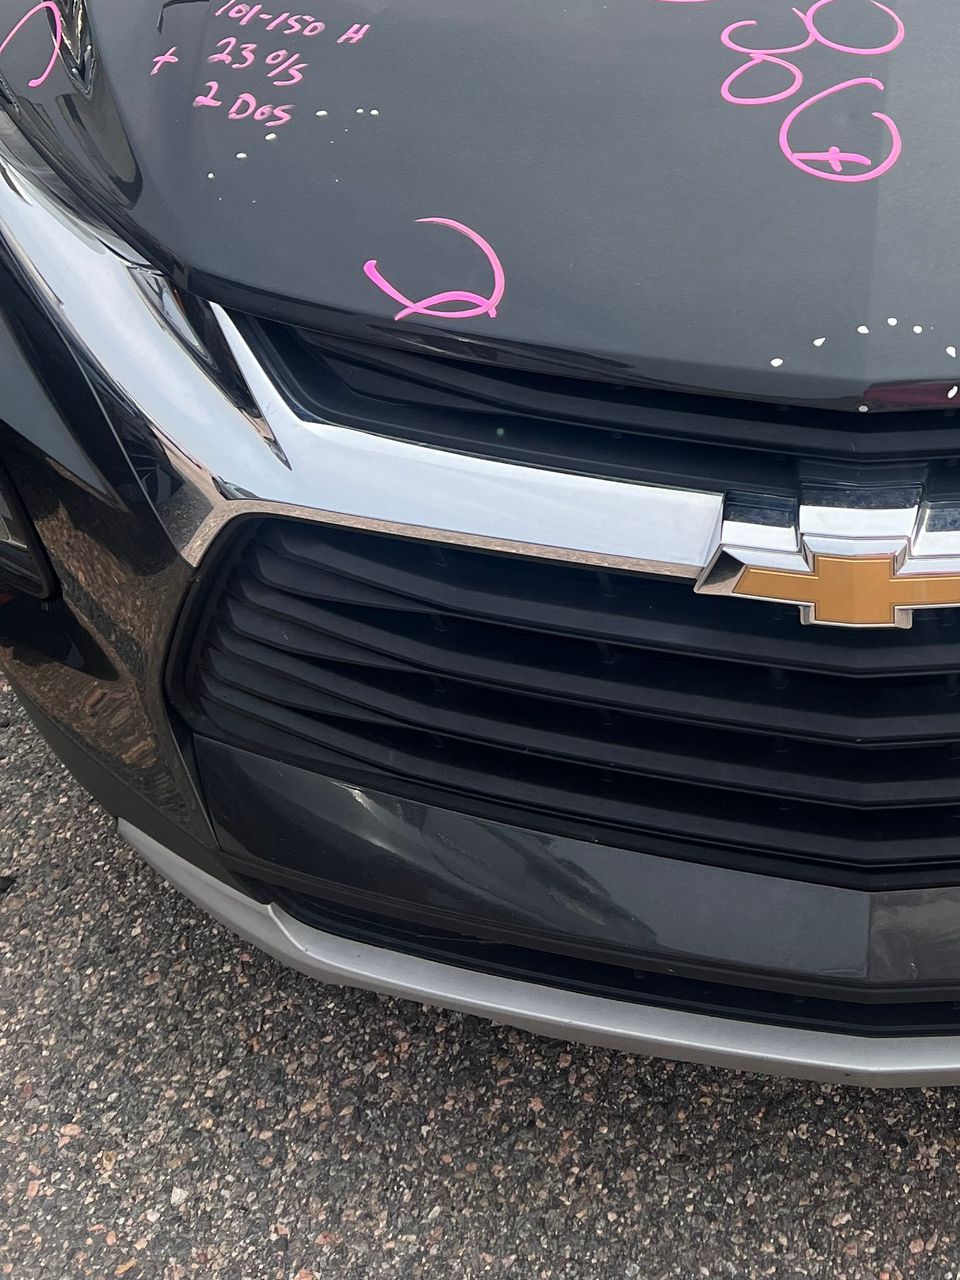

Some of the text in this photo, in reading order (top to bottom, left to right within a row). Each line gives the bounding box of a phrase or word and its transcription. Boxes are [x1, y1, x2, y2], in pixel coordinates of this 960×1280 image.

[336, 23, 371, 44] H
[207, 36, 258, 69] 23
[192, 80, 223, 108] 2
